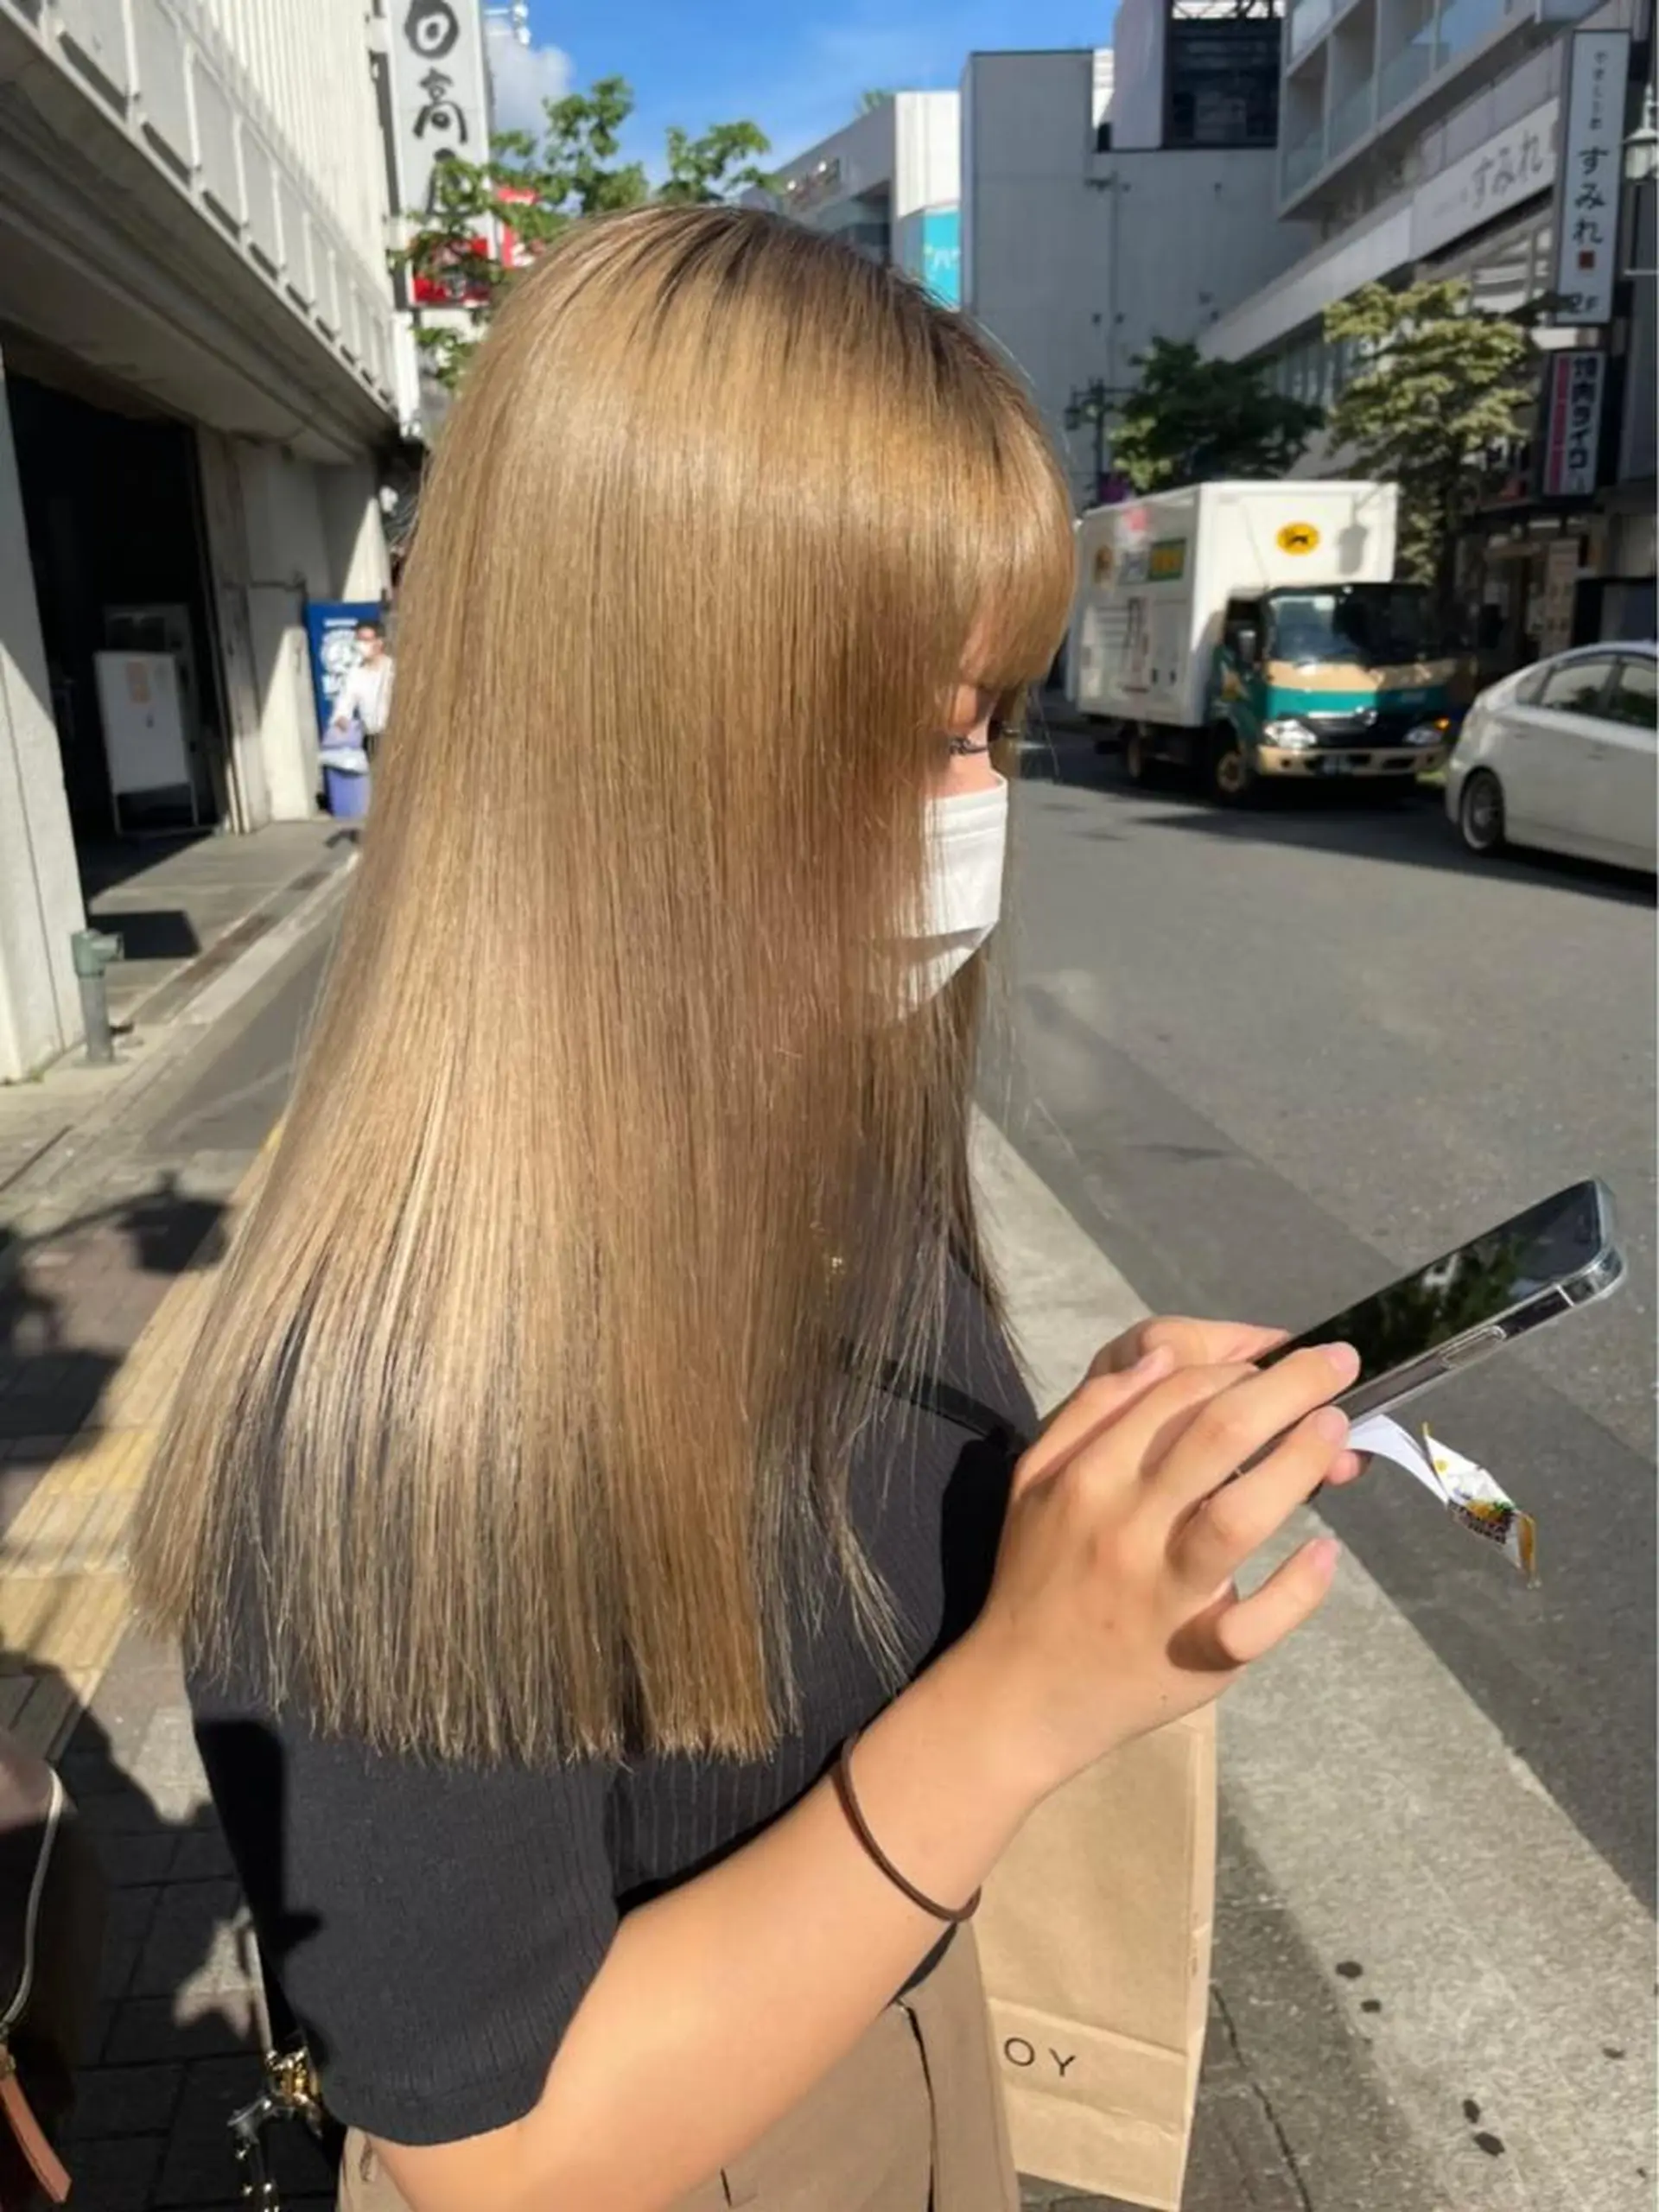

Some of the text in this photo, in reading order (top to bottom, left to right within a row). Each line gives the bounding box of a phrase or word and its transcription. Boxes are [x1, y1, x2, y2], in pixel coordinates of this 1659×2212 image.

[1471, 130, 1544, 212] すみれ
[1573, 145, 1610, 245] すみれ
